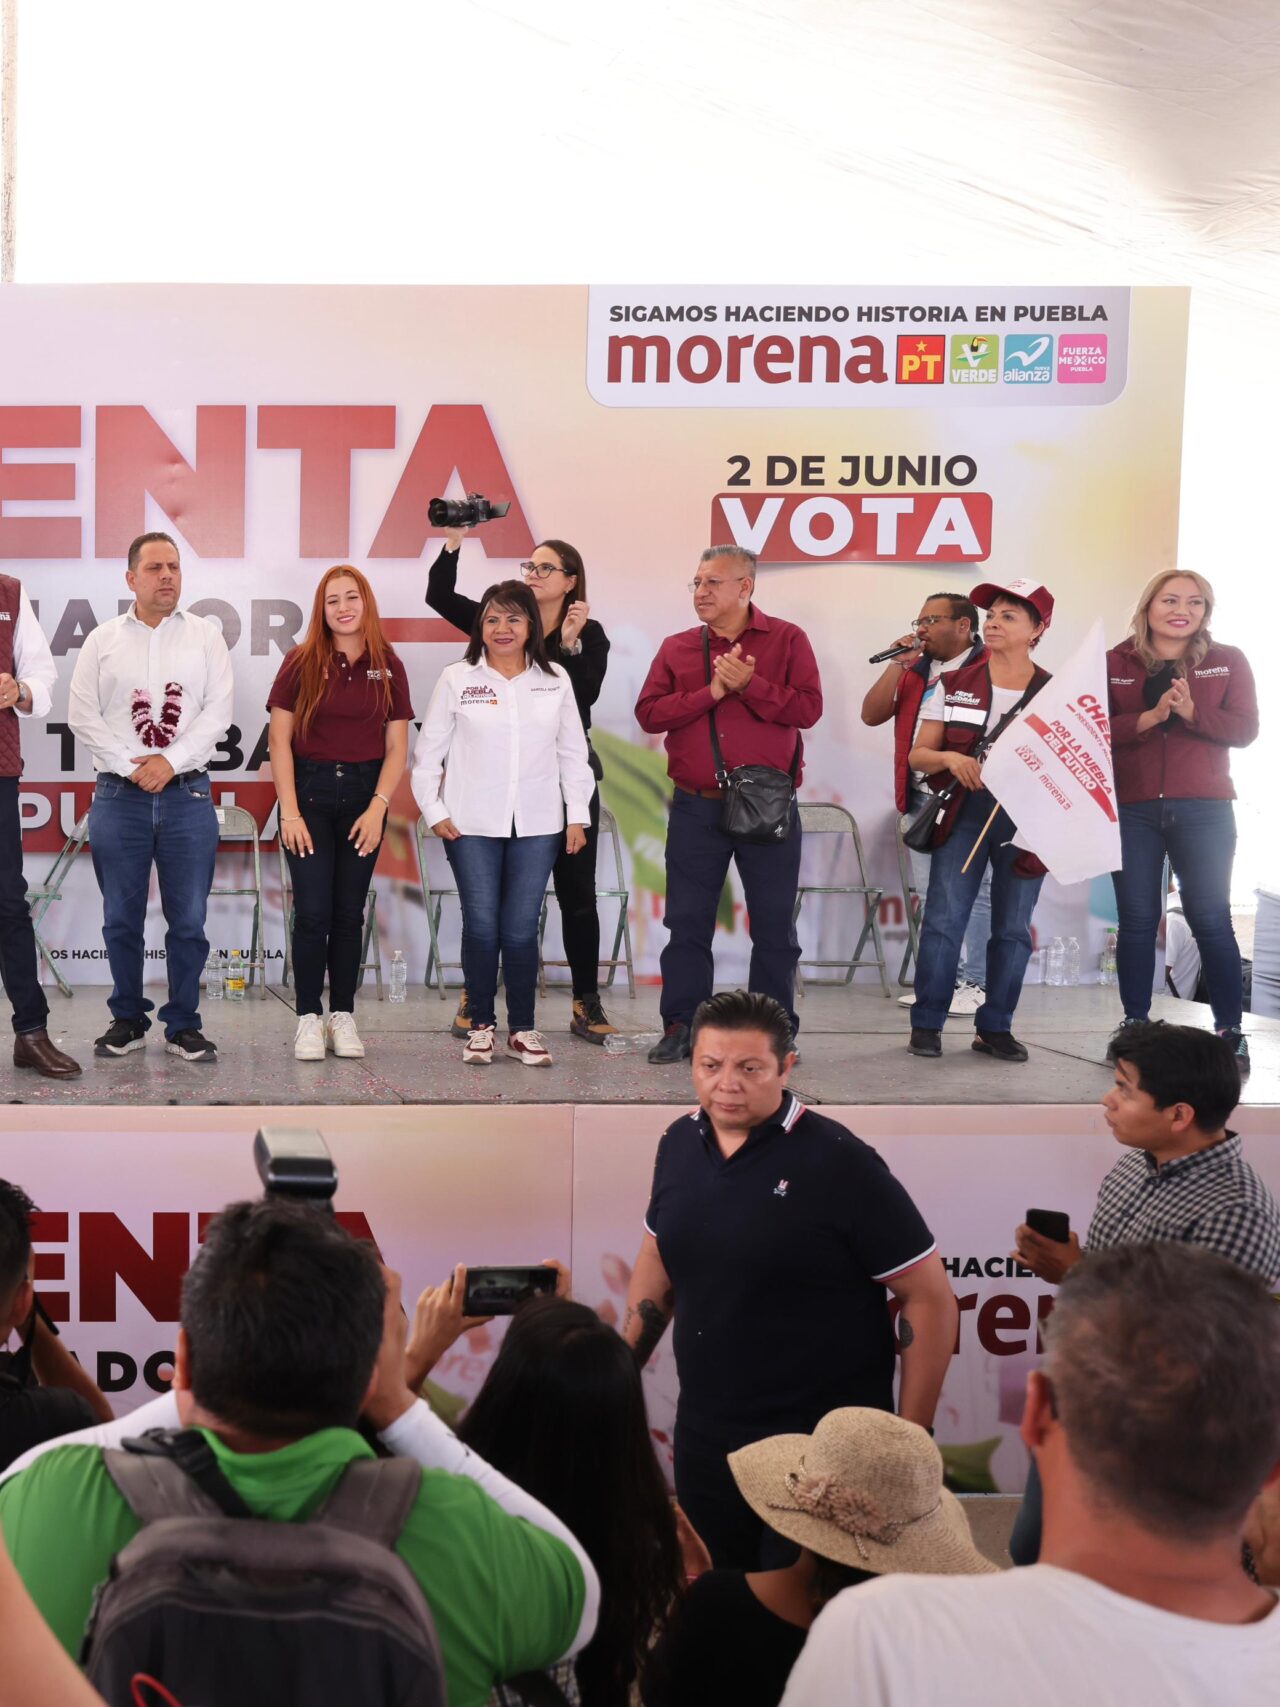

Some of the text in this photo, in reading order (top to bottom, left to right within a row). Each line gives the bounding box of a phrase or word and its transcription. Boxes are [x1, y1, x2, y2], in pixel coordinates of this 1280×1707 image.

[609, 304, 1108, 323] SIGAMOS HACIENDO HISTORIA EN PUEBLA
[607, 334, 888, 384] morena
[1063, 347, 1102, 356] FUERZA
[901, 355, 942, 380] PT
[952, 369, 997, 383] VERDE
[1004, 369, 1050, 382] alianza
[726, 455, 978, 487] 2 DE JUNIO
[719, 497, 983, 556] VOTA
[1195, 666, 1229, 676] morena
[1043, 733, 1097, 791] DEL FUTURO
[1050, 720, 1070, 739] POR
[1067, 738, 1082, 753] LA
[1079, 752, 1112, 794] PUEBLA
[1039, 774, 1066, 805] morena
